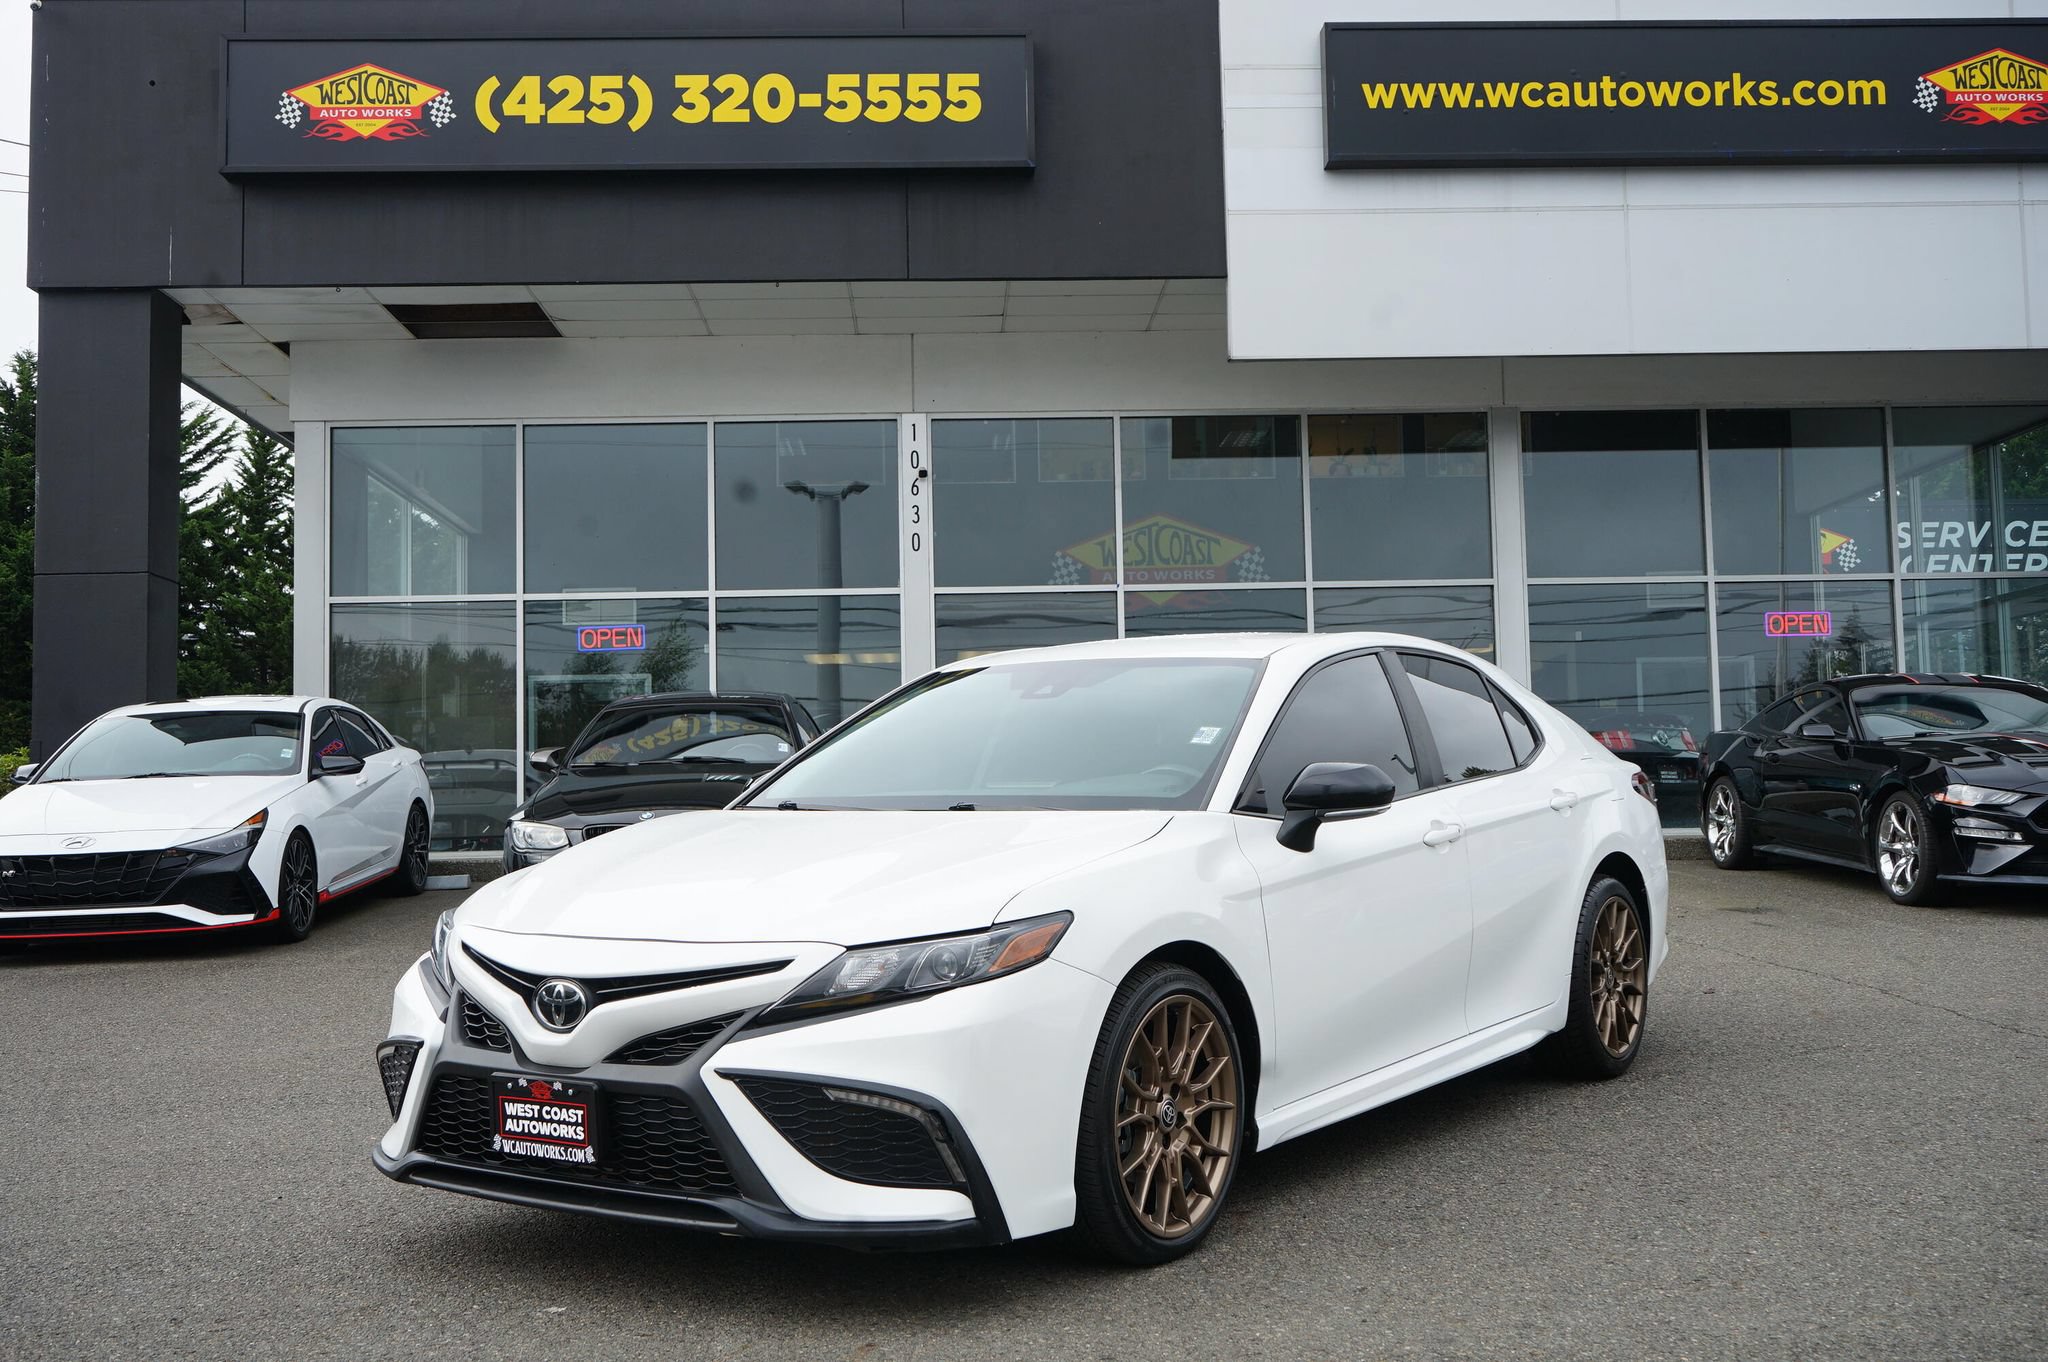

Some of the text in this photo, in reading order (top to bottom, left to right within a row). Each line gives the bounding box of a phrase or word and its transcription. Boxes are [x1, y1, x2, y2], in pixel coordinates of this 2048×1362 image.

[1362, 73, 1887, 109] www.wcautoworks.com
[1955, 93, 2044, 102] AUTO WORKS
[319, 108, 413, 118] AUTO WORKS
[475, 72, 983, 134] (425) 320-5555
[1896, 520, 2048, 549] SERVCE
[1102, 569, 1216, 583] ATO WORKS
[1768, 613, 1829, 635] OPEN
[580, 626, 642, 649] OPEN
[504, 1102, 584, 1124] WEST COAST
[505, 1118, 585, 1140] AUTOWORKS
[502, 1138, 585, 1163] WCAUTOWORKS.COM
